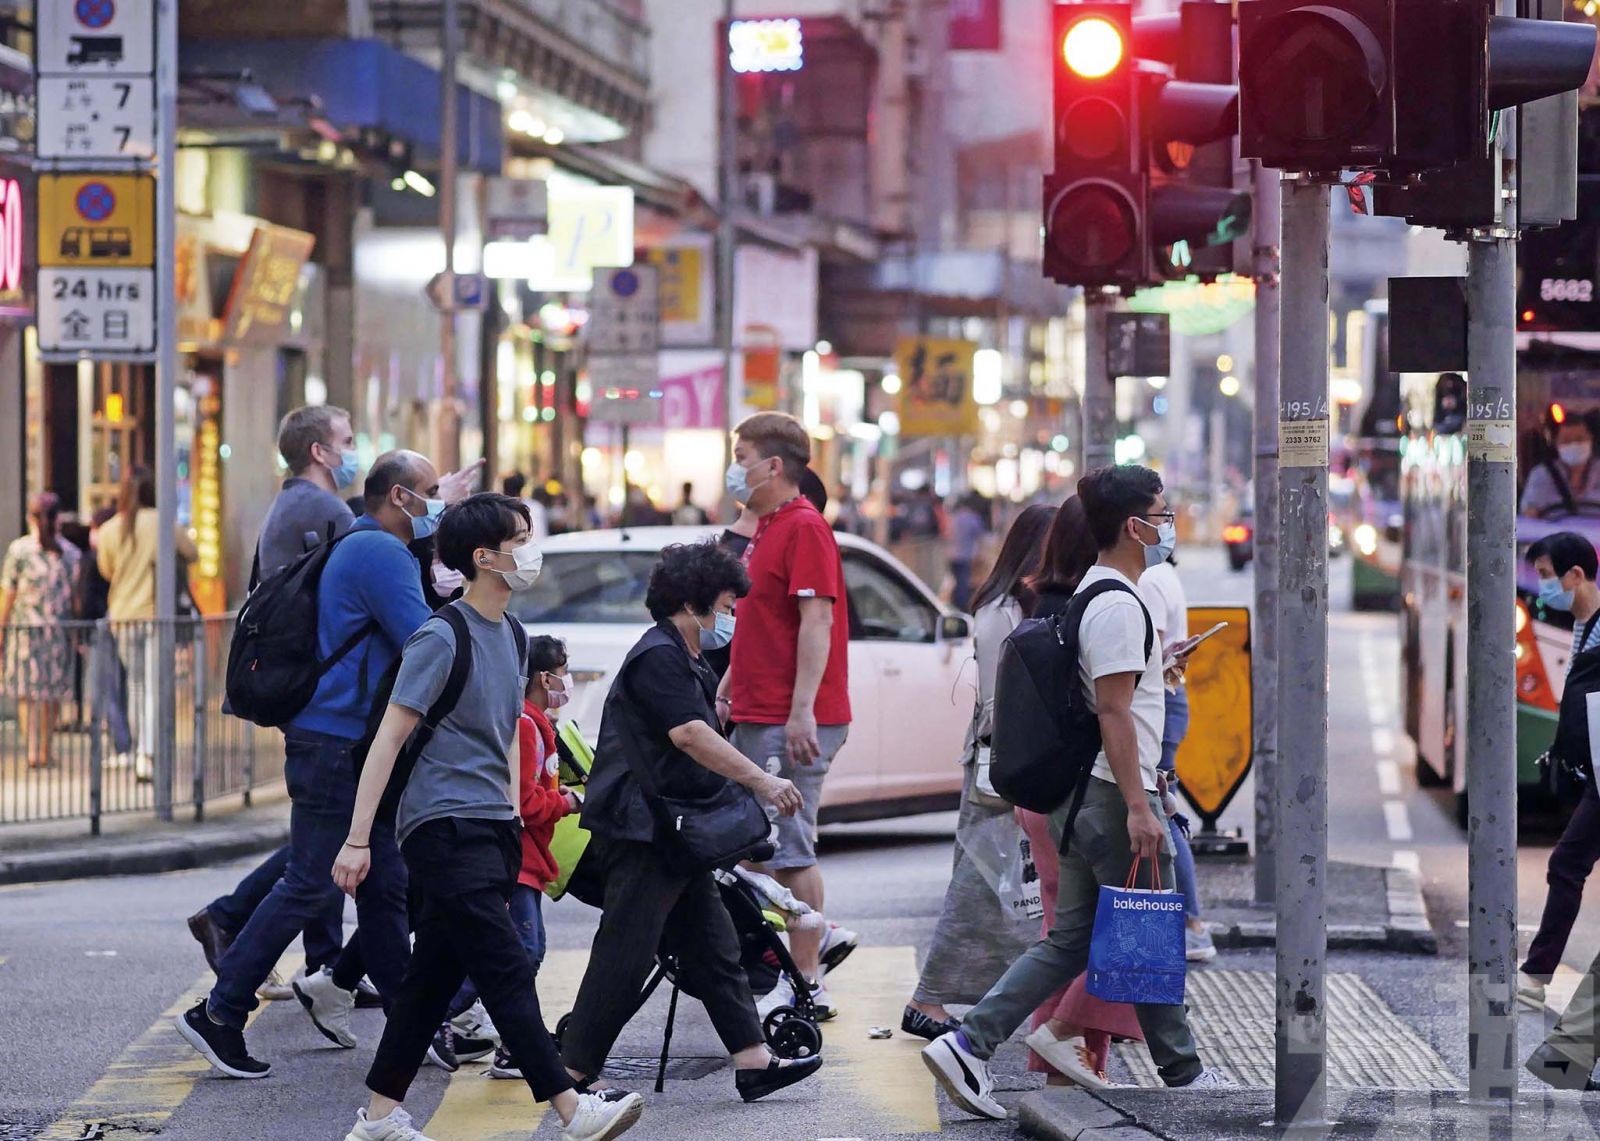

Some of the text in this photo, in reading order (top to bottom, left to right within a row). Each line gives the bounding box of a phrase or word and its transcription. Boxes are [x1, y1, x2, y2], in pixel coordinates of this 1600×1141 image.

[113, 82, 131, 109] 7
[113, 126, 131, 152] 7
[54, 277, 140, 299] 24 hrs
[62, 308, 128, 341] 全日
[1285, 436, 1302, 444] 2333
[1113, 897, 1183, 911] bakehouse
